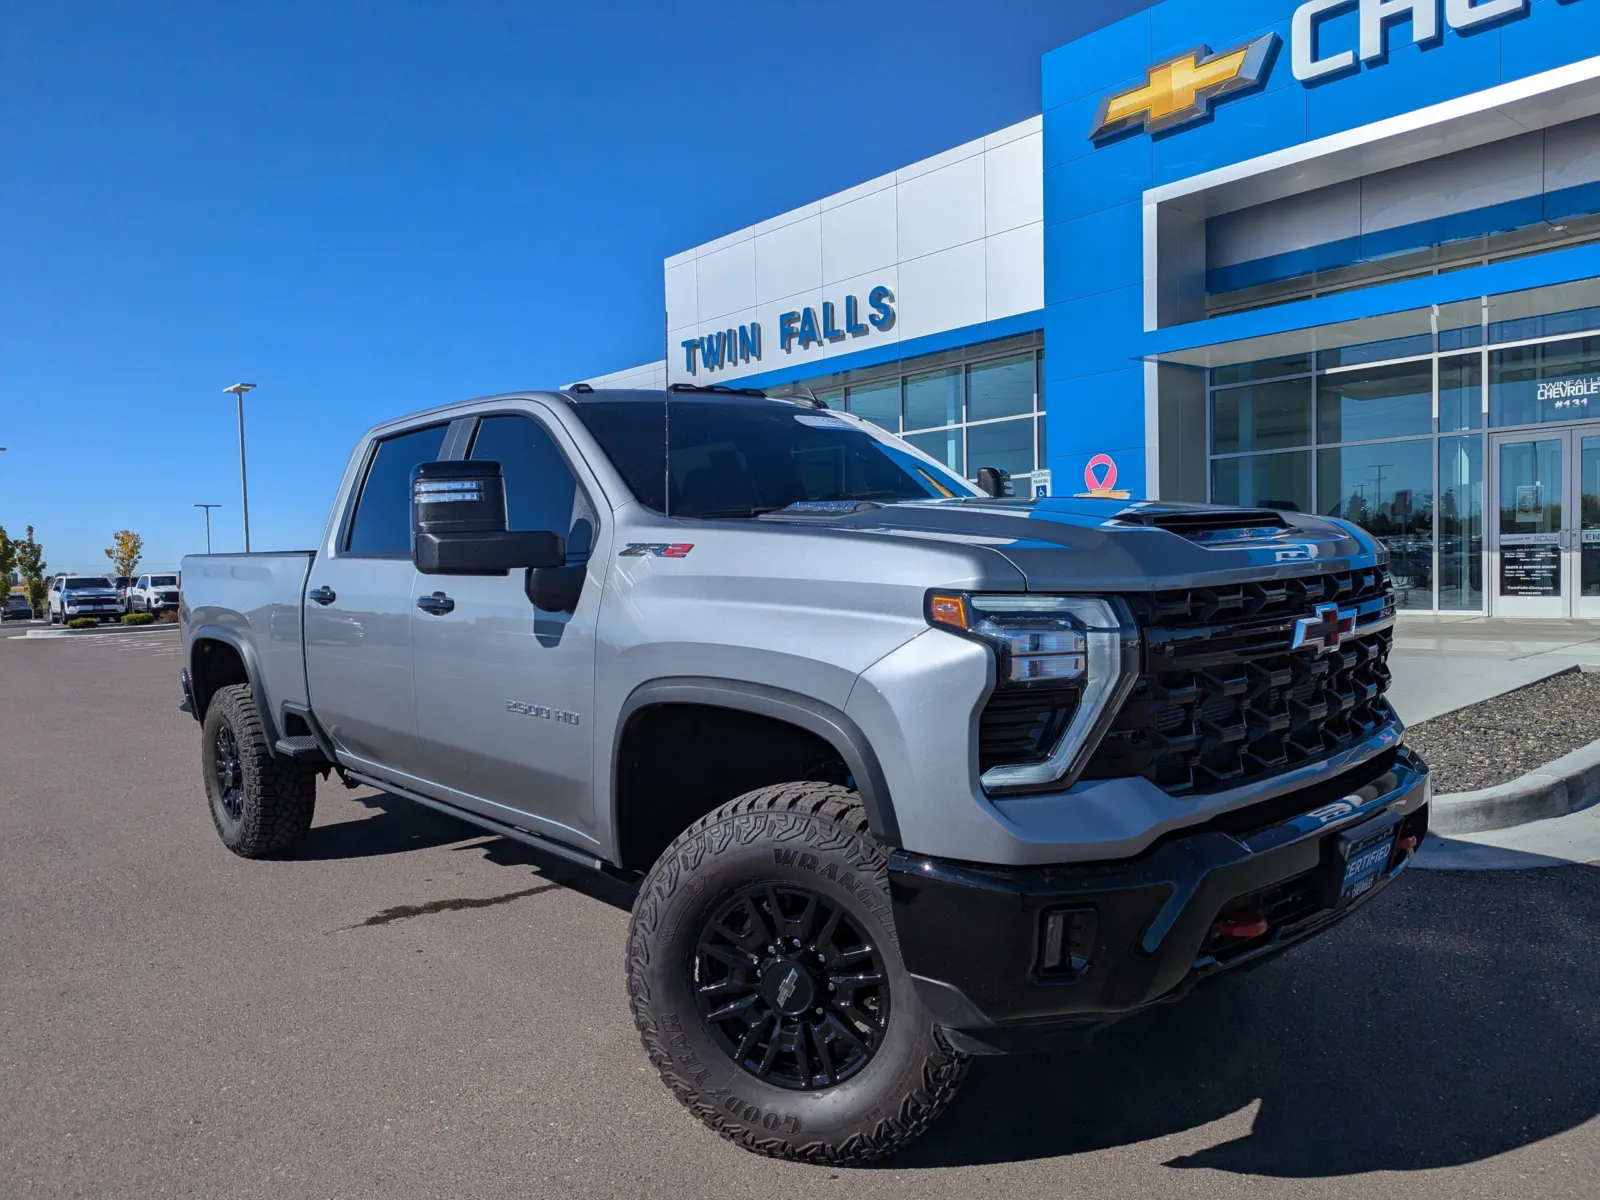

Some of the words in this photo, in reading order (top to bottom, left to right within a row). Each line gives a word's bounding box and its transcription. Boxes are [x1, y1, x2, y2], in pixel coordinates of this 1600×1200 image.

[681, 322, 761, 376] TWIN
[780, 285, 896, 354] FALLS
[1537, 382, 1600, 400] CHEVROLE
[1555, 398, 1588, 410] #131
[618, 543, 695, 558] ZR2
[506, 700, 551, 720] 2500
[554, 708, 579, 726] HD
